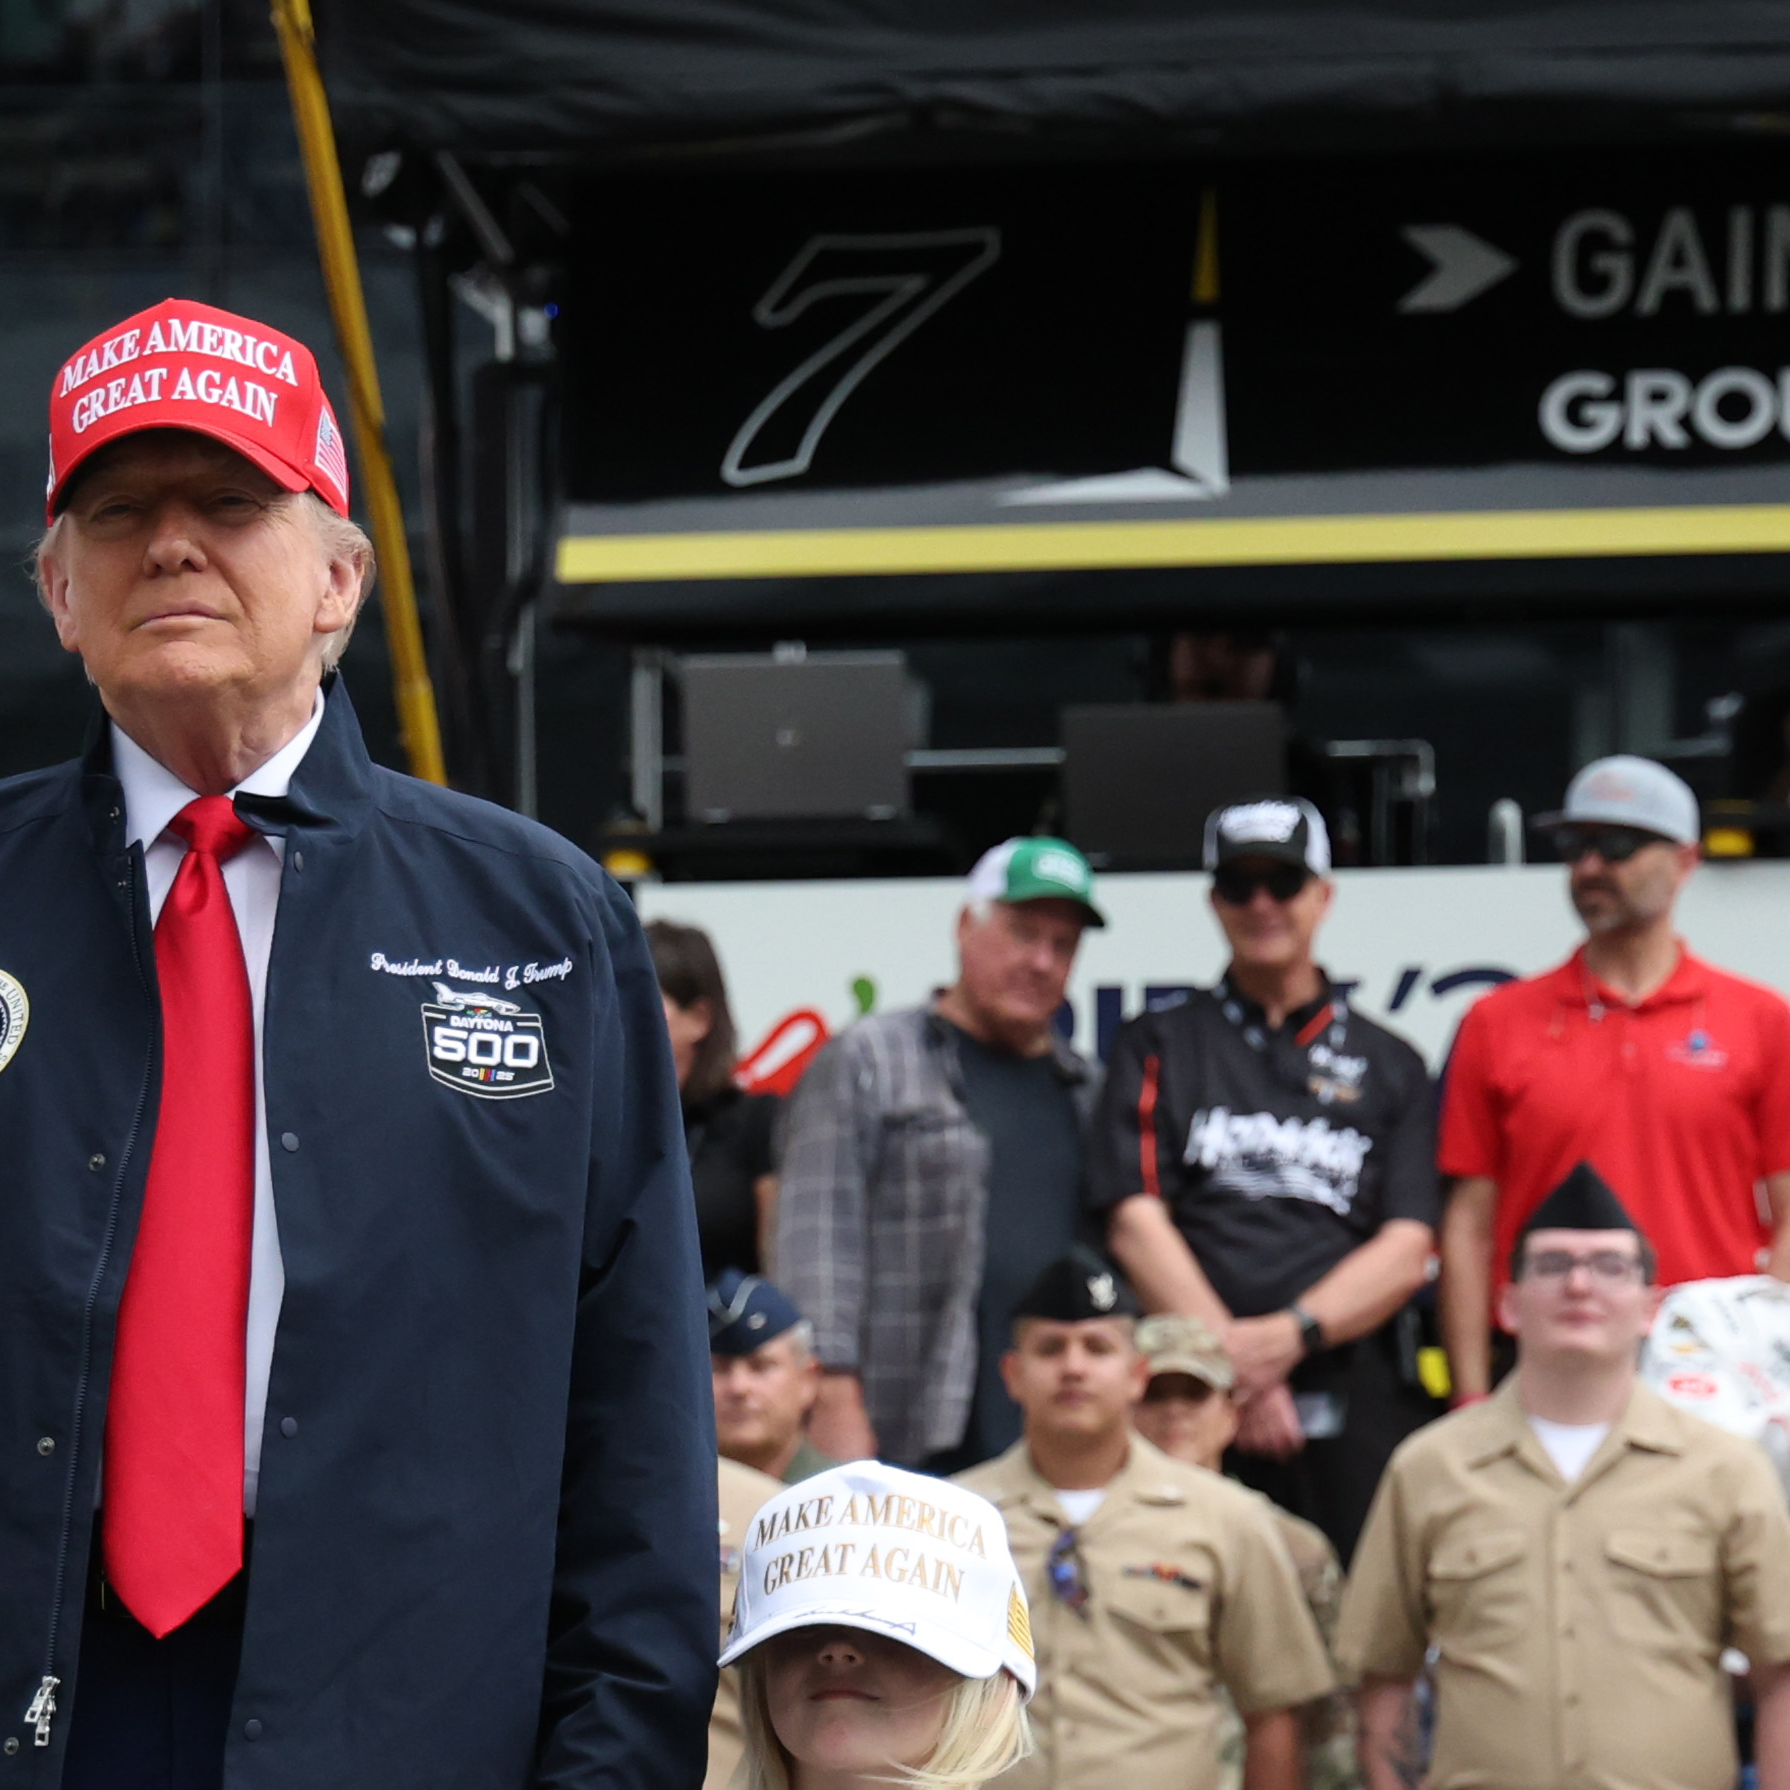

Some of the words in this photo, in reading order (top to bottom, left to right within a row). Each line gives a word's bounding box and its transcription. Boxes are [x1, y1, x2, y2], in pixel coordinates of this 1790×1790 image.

[60, 328, 141, 398] MAKE
[142, 318, 299, 387] AMERICA
[720, 226, 1001, 487] 7
[72, 367, 168, 434] GREAT
[171, 367, 278, 428] AGAIN
[370, 953, 443, 976] President
[446, 959, 500, 983] Donald
[523, 957, 573, 983] Trump
[5, 987, 24, 1045] UNITED
[450, 1015, 514, 1032] DAYTONA
[432, 1026, 539, 1069] 500
[754, 1494, 834, 1551] MAKE
[838, 1493, 986, 1559] AMERICA
[763, 1543, 856, 1596] GREAT
[860, 1543, 966, 1604] AGAIN
